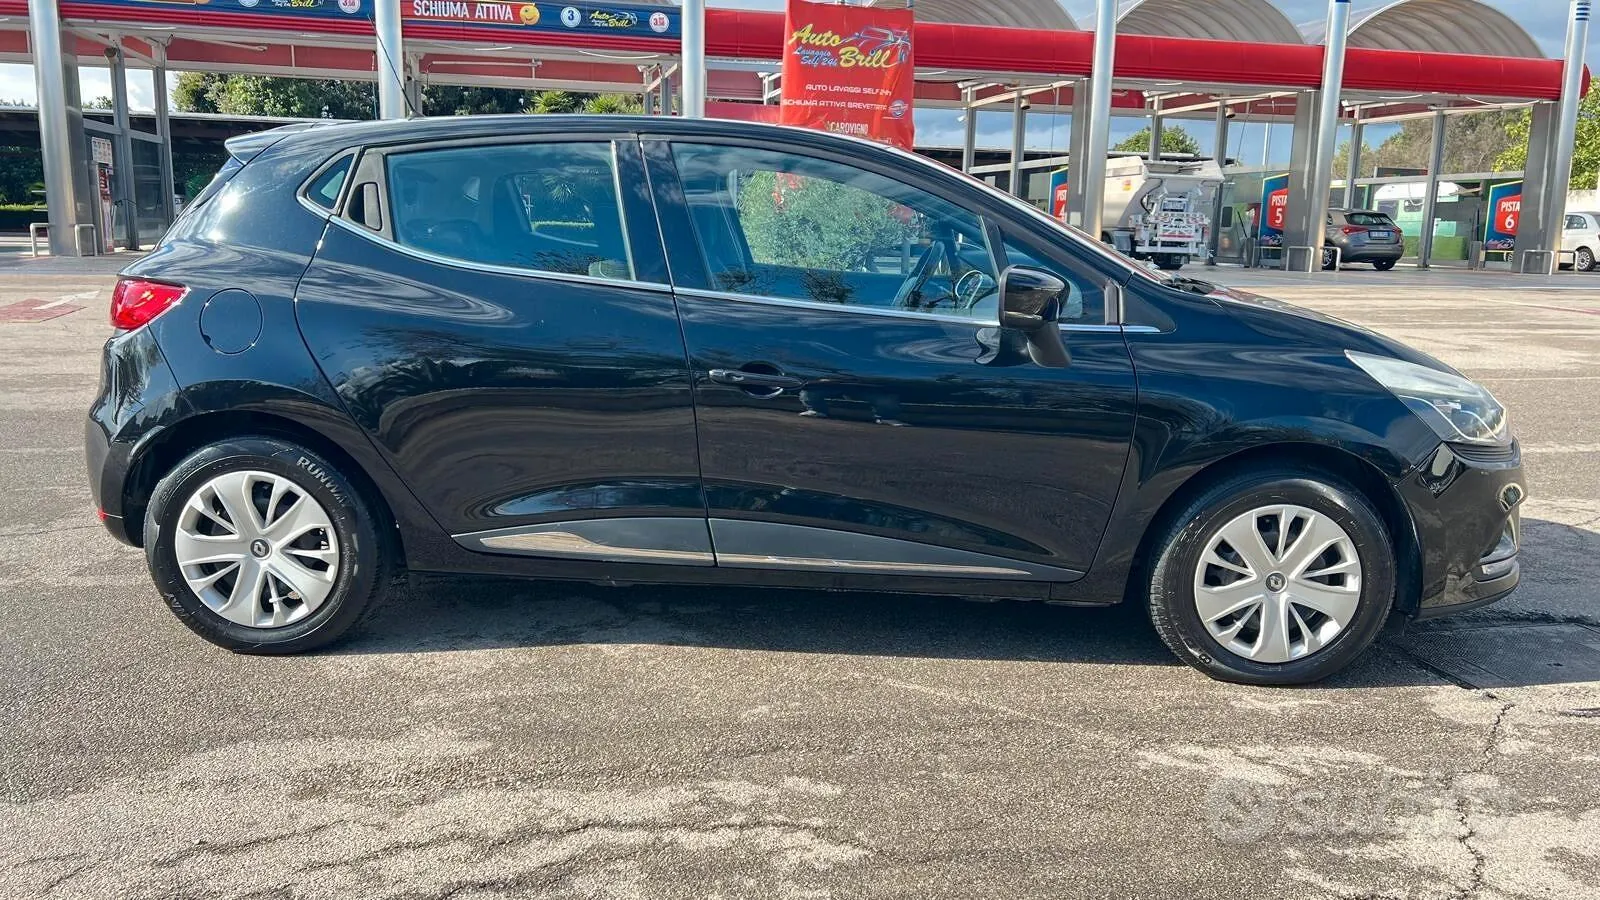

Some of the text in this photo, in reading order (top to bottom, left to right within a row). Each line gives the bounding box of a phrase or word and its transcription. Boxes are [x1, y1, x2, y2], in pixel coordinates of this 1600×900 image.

[413, 0, 514, 21] SCHIUMA ATTIVA
[567, 9, 575, 21] 3
[588, 10, 610, 20] Auto
[608, 18, 633, 28] Brill
[788, 23, 843, 47] Auto
[792, 46, 832, 58] Lavaggio
[839, 46, 899, 68] Brill
[800, 55, 819, 68] Self
[805, 83, 828, 92] AUTO
[828, 85, 862, 94] LAVAGGI
[862, 87, 880, 95] SELF
[782, 98, 888, 111] SCHIUMA ATTIVA BREVETTATA
[830, 121, 869, 135] CAROVIGNO
[1056, 189, 1068, 202] PIST
[1500, 200, 1521, 212] PISTA
[1274, 207, 1283, 224] 5
[1504, 213, 1515, 229] 6
